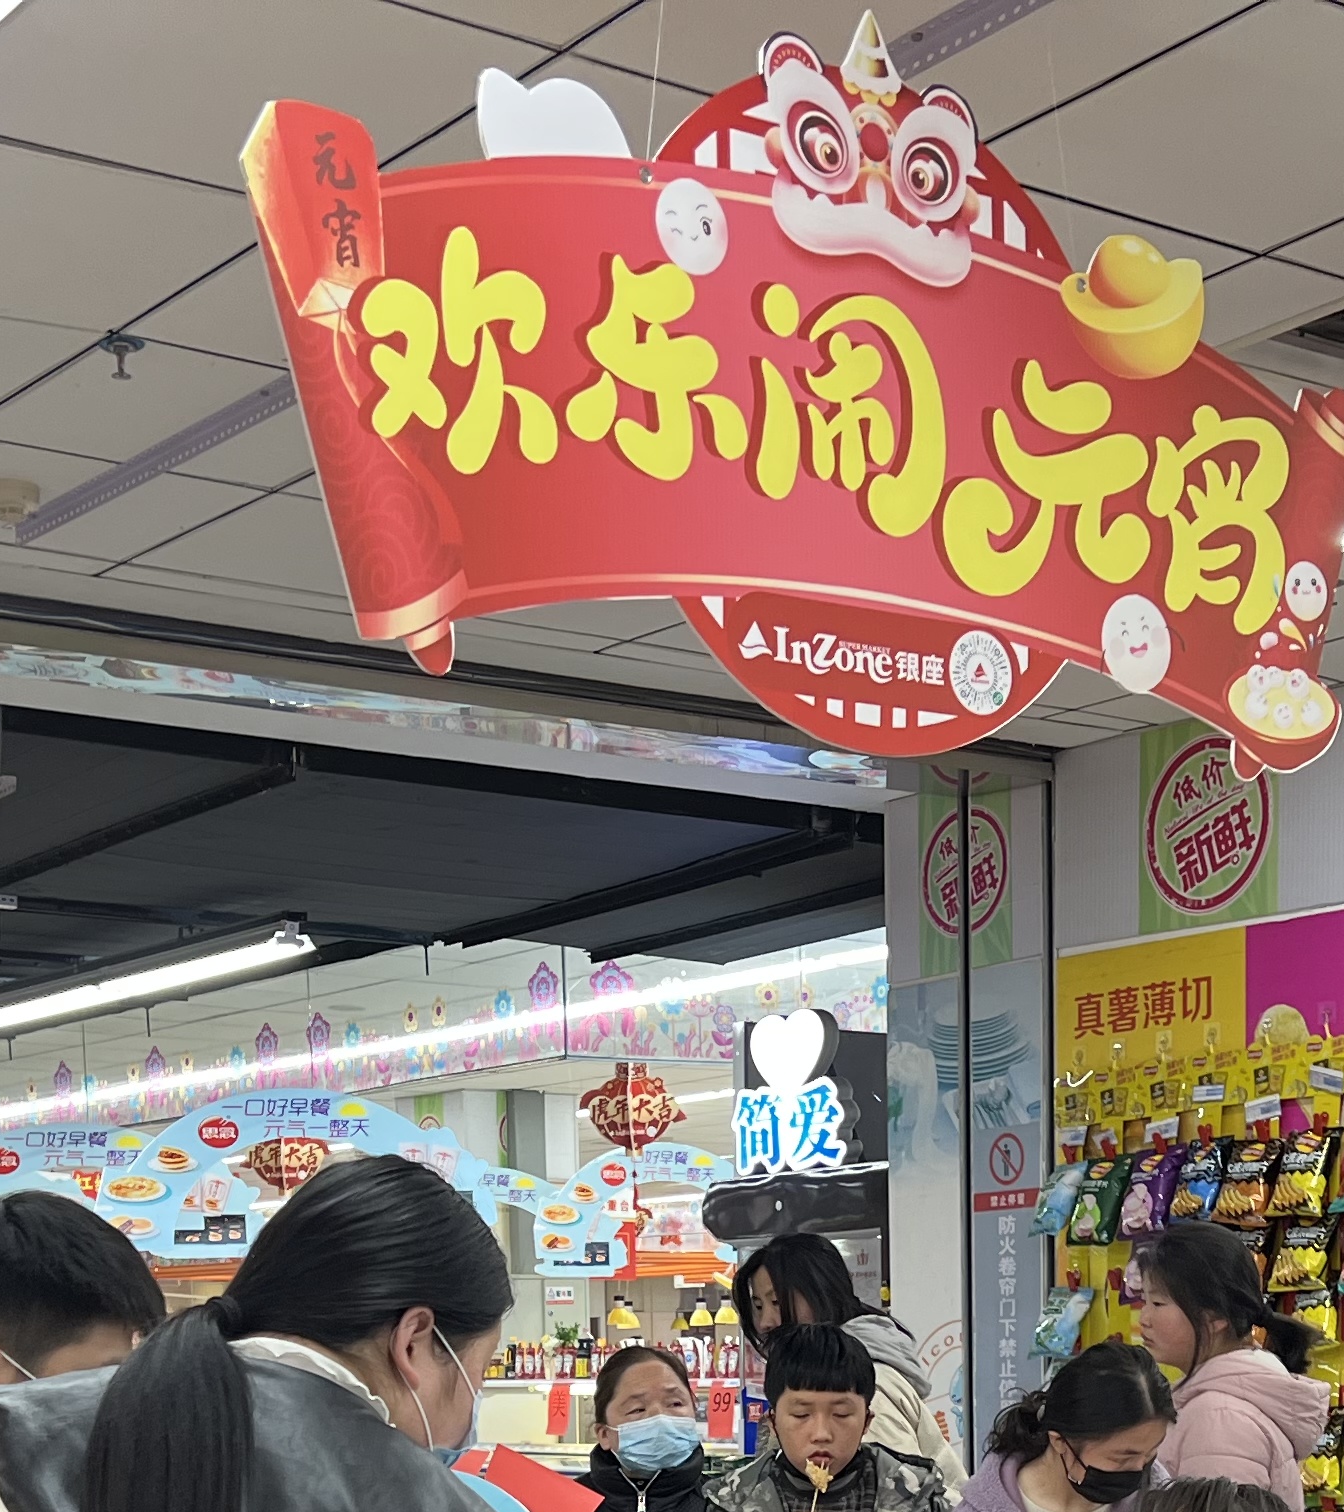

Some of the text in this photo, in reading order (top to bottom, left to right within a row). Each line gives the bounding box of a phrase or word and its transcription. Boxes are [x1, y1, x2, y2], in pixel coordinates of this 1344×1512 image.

[314, 131, 361, 270] 元宵
[361, 225, 1289, 636] 欢乐闹元宵
[773, 625, 945, 686] InZone 银座
[1172, 757, 1228, 809] 低价
[1174, 799, 1255, 893] 新鲜
[1075, 977, 1212, 1038] 真薯薄切
[222, 1098, 330, 1117] 一口好早餐
[263, 1118, 370, 1139] 元气一整天
[591, 1097, 676, 1124] 虎年大吉
[738, 1087, 840, 1167] 简爱
[3, 1131, 108, 1149] 一口好早餐
[44, 1149, 143, 1167] 元气一整天
[248, 1141, 319, 1168] 虎年大吉
